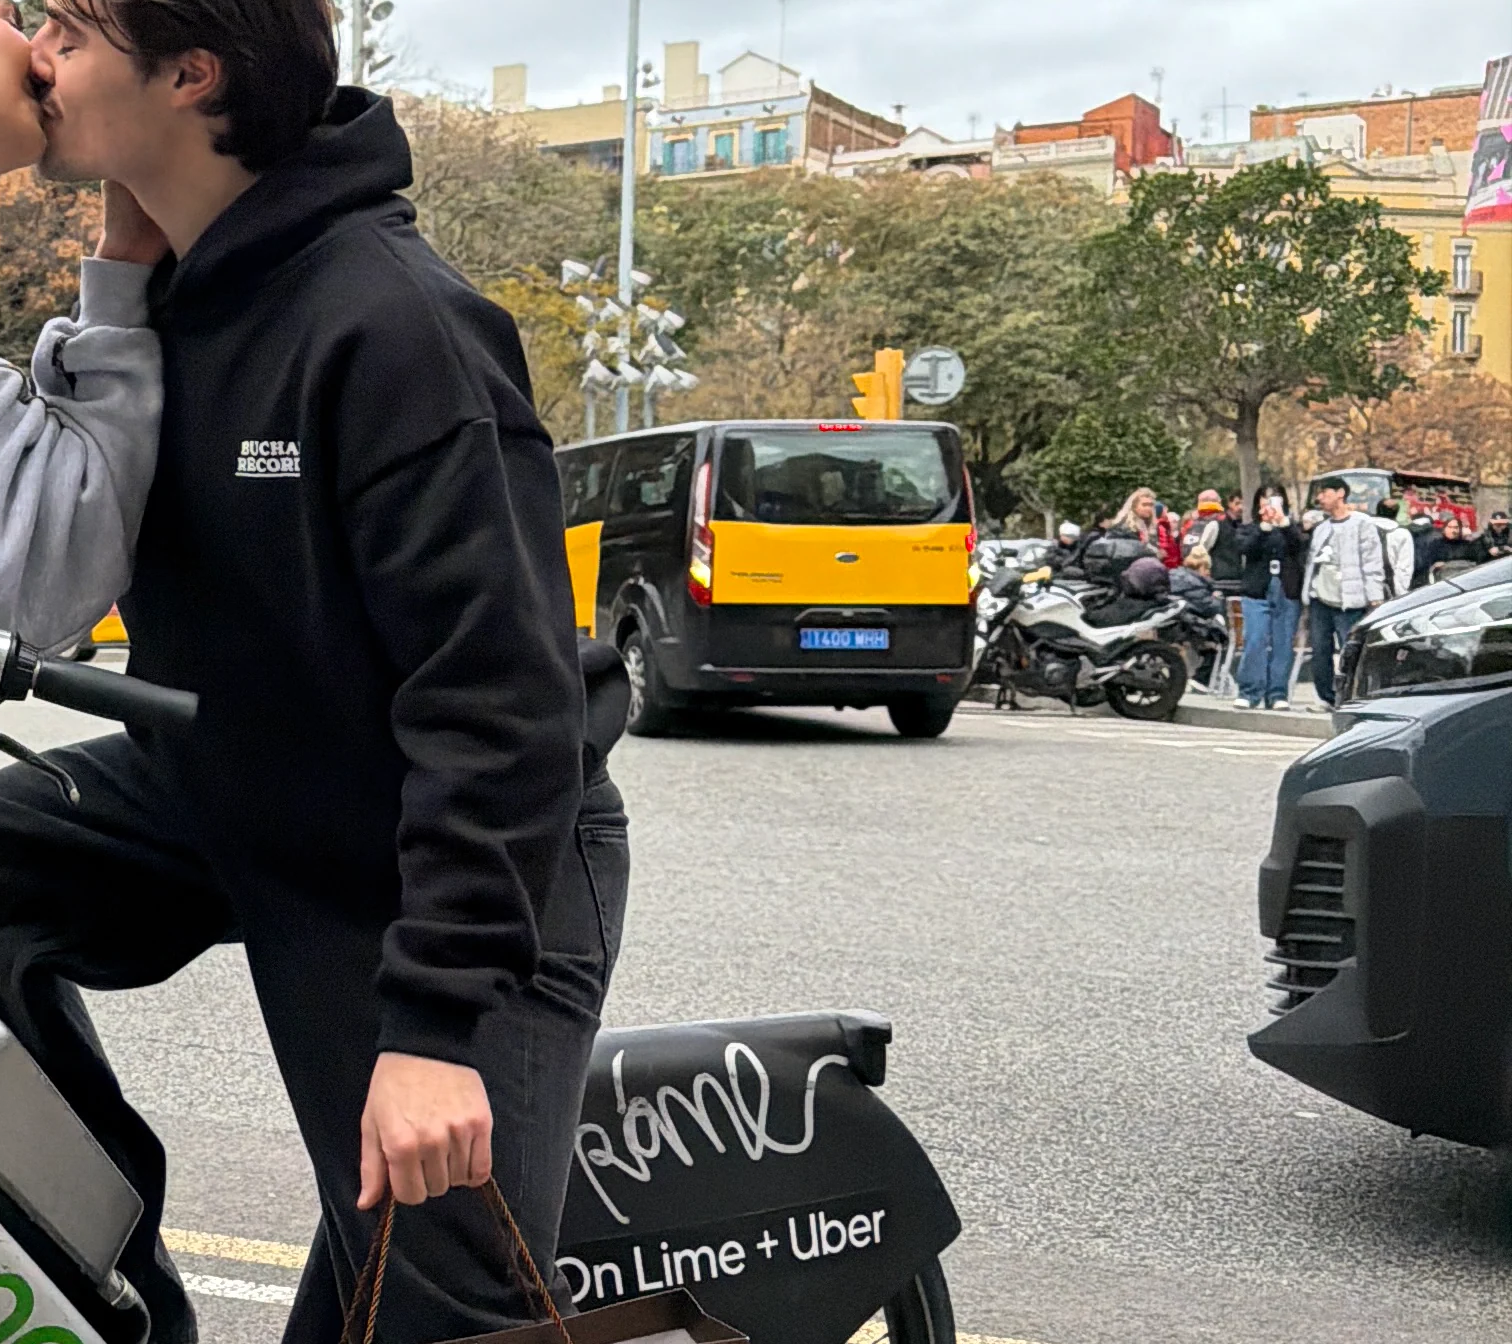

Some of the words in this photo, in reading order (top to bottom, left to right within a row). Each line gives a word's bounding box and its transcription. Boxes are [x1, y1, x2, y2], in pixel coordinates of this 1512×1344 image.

[240, 440, 301, 456] BUCHA
[554, 1255, 624, 1304] On
[633, 1241, 746, 1292] Lime
[756, 1229, 779, 1259] +
[787, 1209, 886, 1261] Uber
